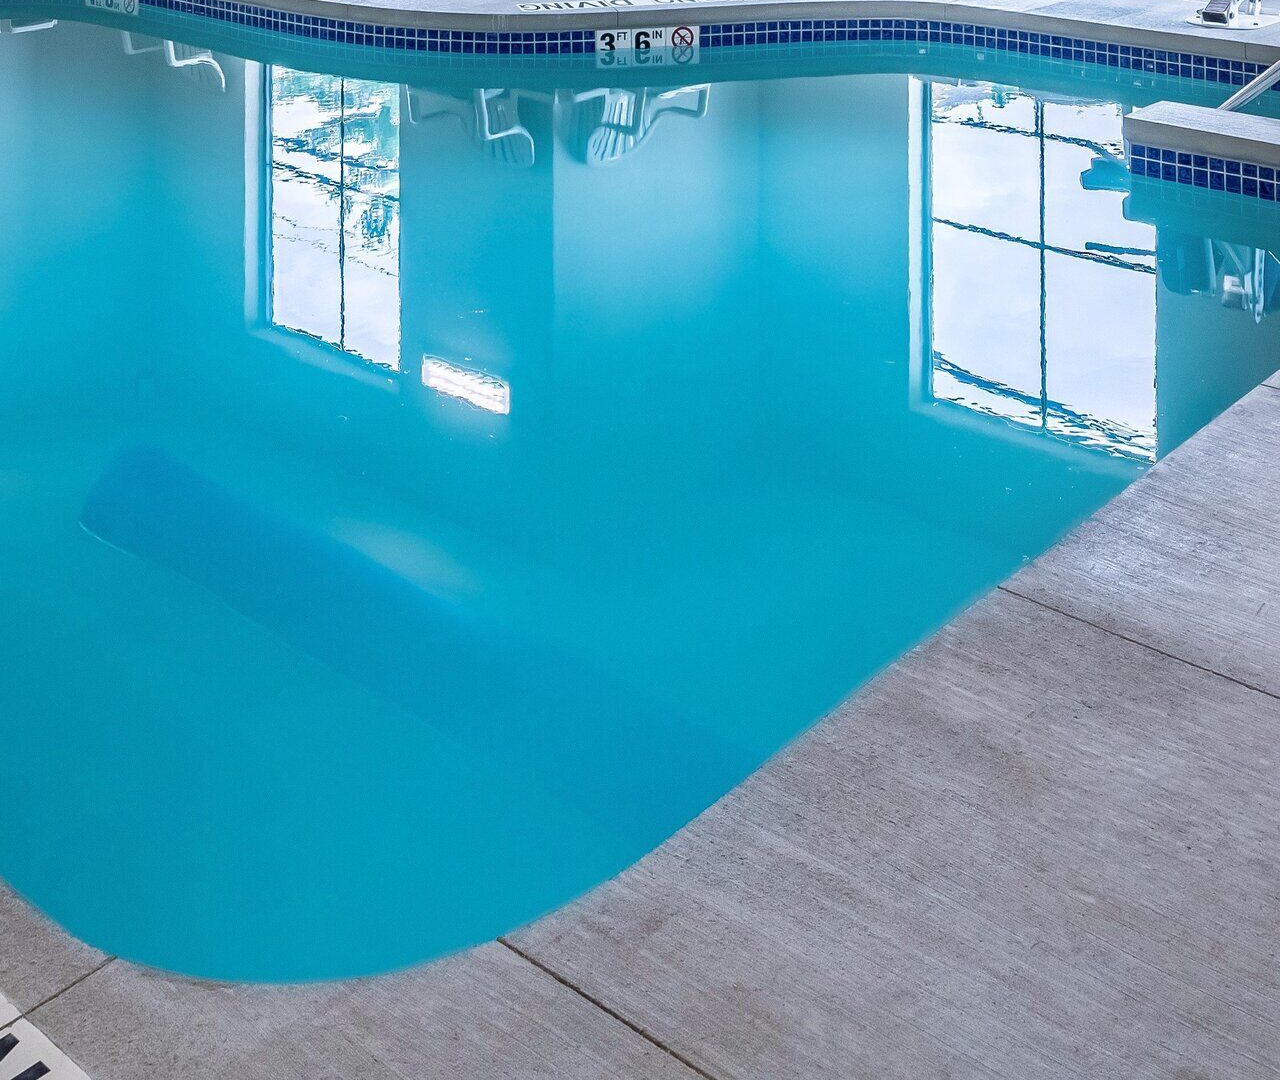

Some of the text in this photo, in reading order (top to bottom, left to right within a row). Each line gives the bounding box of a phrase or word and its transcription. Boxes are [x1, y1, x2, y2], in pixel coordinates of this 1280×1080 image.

[519, 0, 634, 11] DIVING
[600, 30, 663, 51] 3 FT 6 IN
